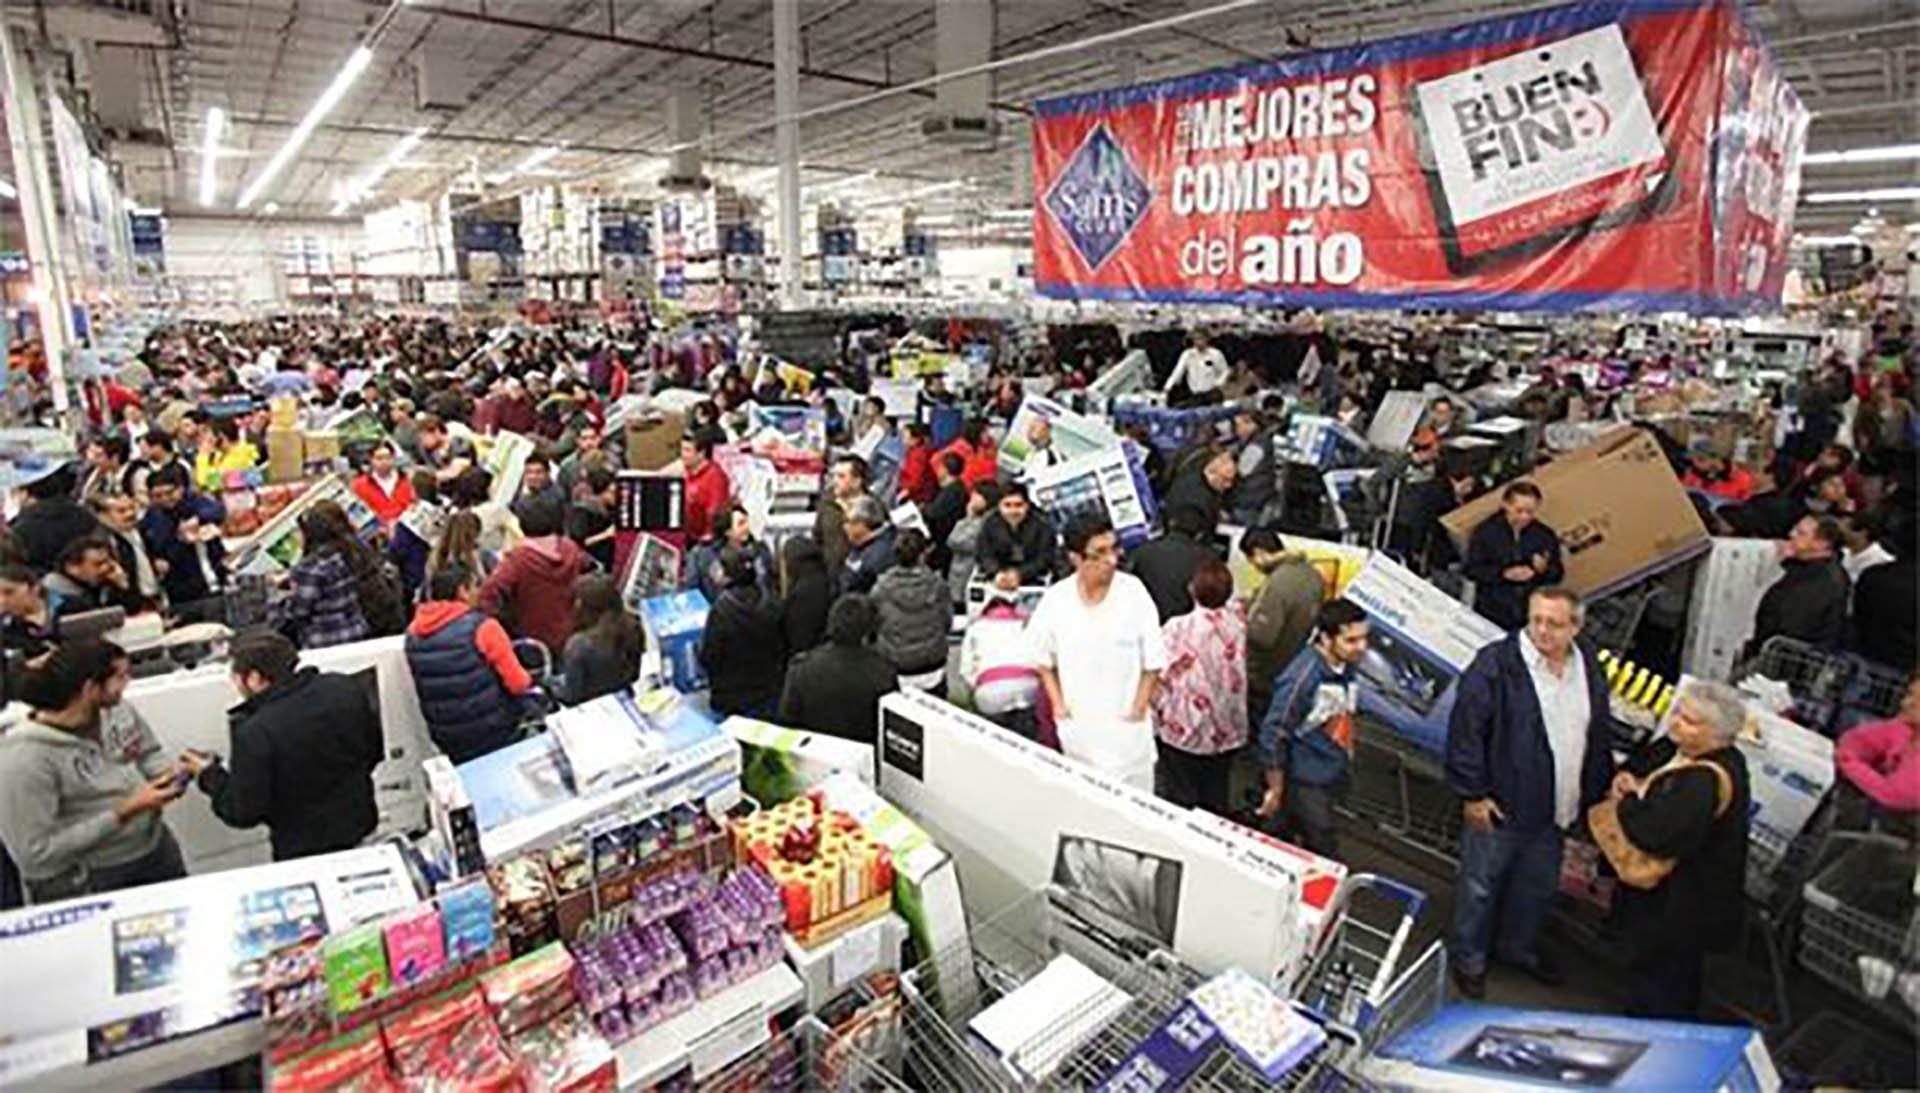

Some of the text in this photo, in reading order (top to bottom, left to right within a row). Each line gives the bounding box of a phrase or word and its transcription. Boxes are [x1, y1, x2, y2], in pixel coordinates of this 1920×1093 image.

[1192, 74, 1376, 150] MEJORES
[1452, 60, 1602, 136] BUEN
[1172, 148, 1371, 216] COMPRAS
[1181, 216, 1364, 285] del año
